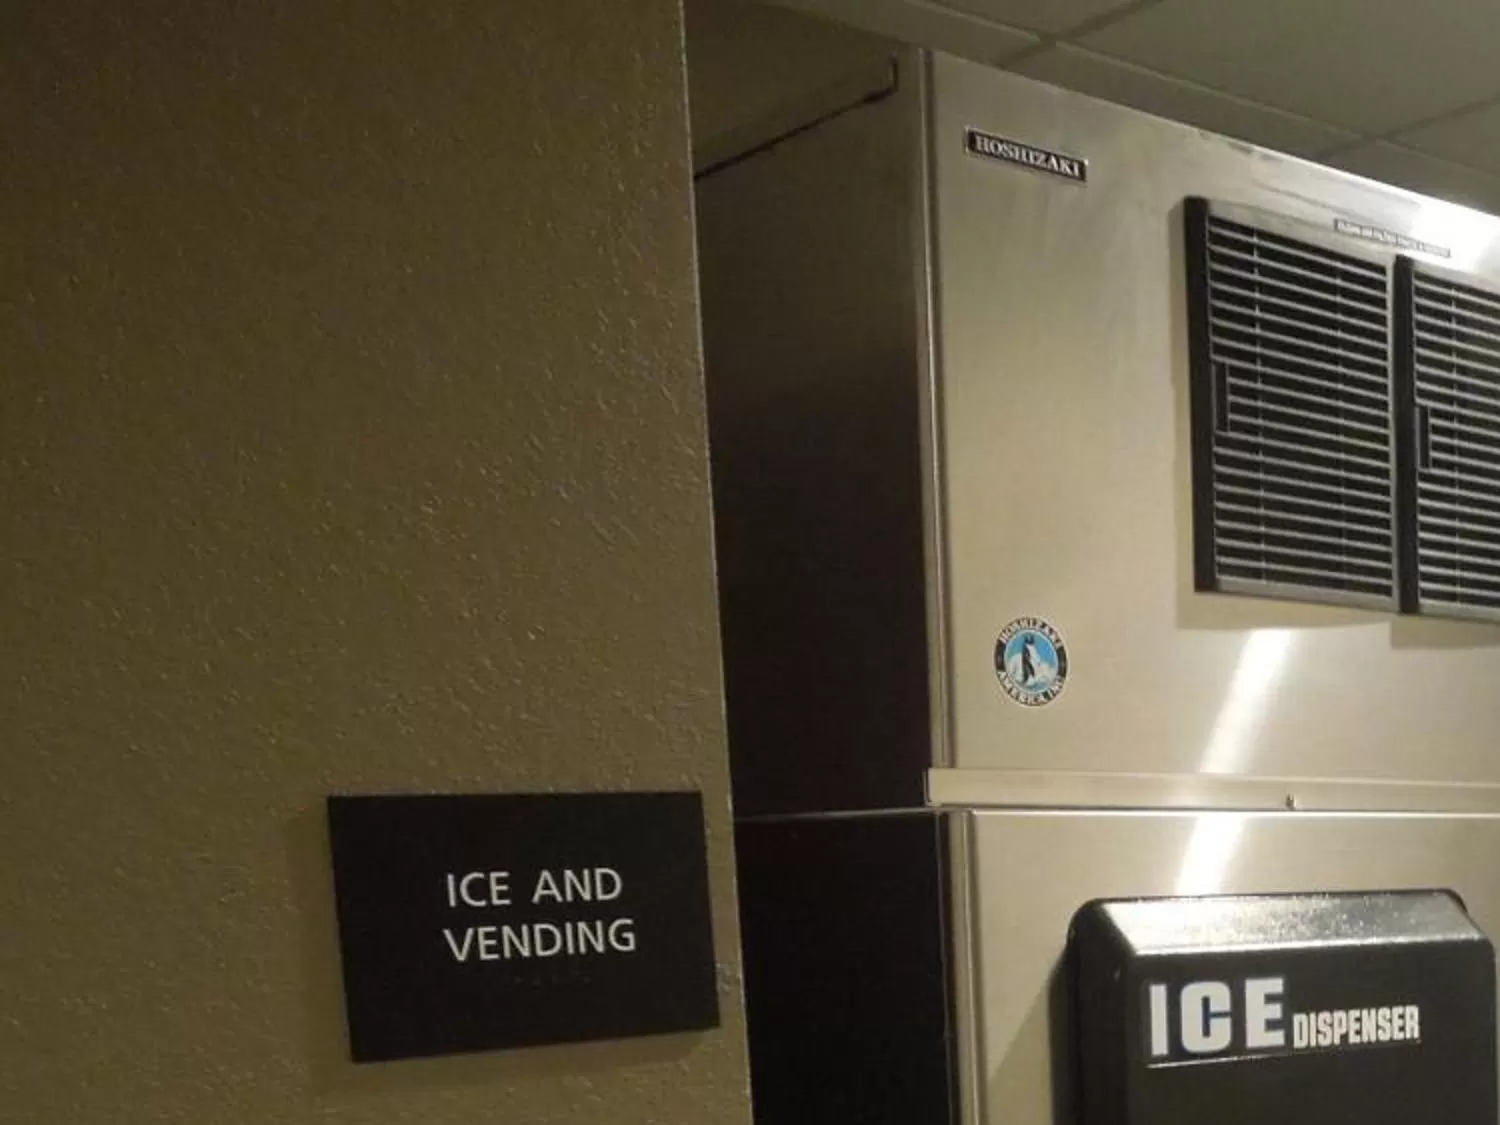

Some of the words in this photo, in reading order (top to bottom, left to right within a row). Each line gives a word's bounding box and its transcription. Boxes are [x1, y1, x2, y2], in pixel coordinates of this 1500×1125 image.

[974, 134, 1080, 177] HOSHIZAKI
[446, 871, 512, 908] ICE
[532, 867, 623, 905] AND
[442, 918, 637, 962] VENDING
[1149, 976, 1286, 1057] ICE
[1292, 1004, 1421, 1050] DISPENSER
